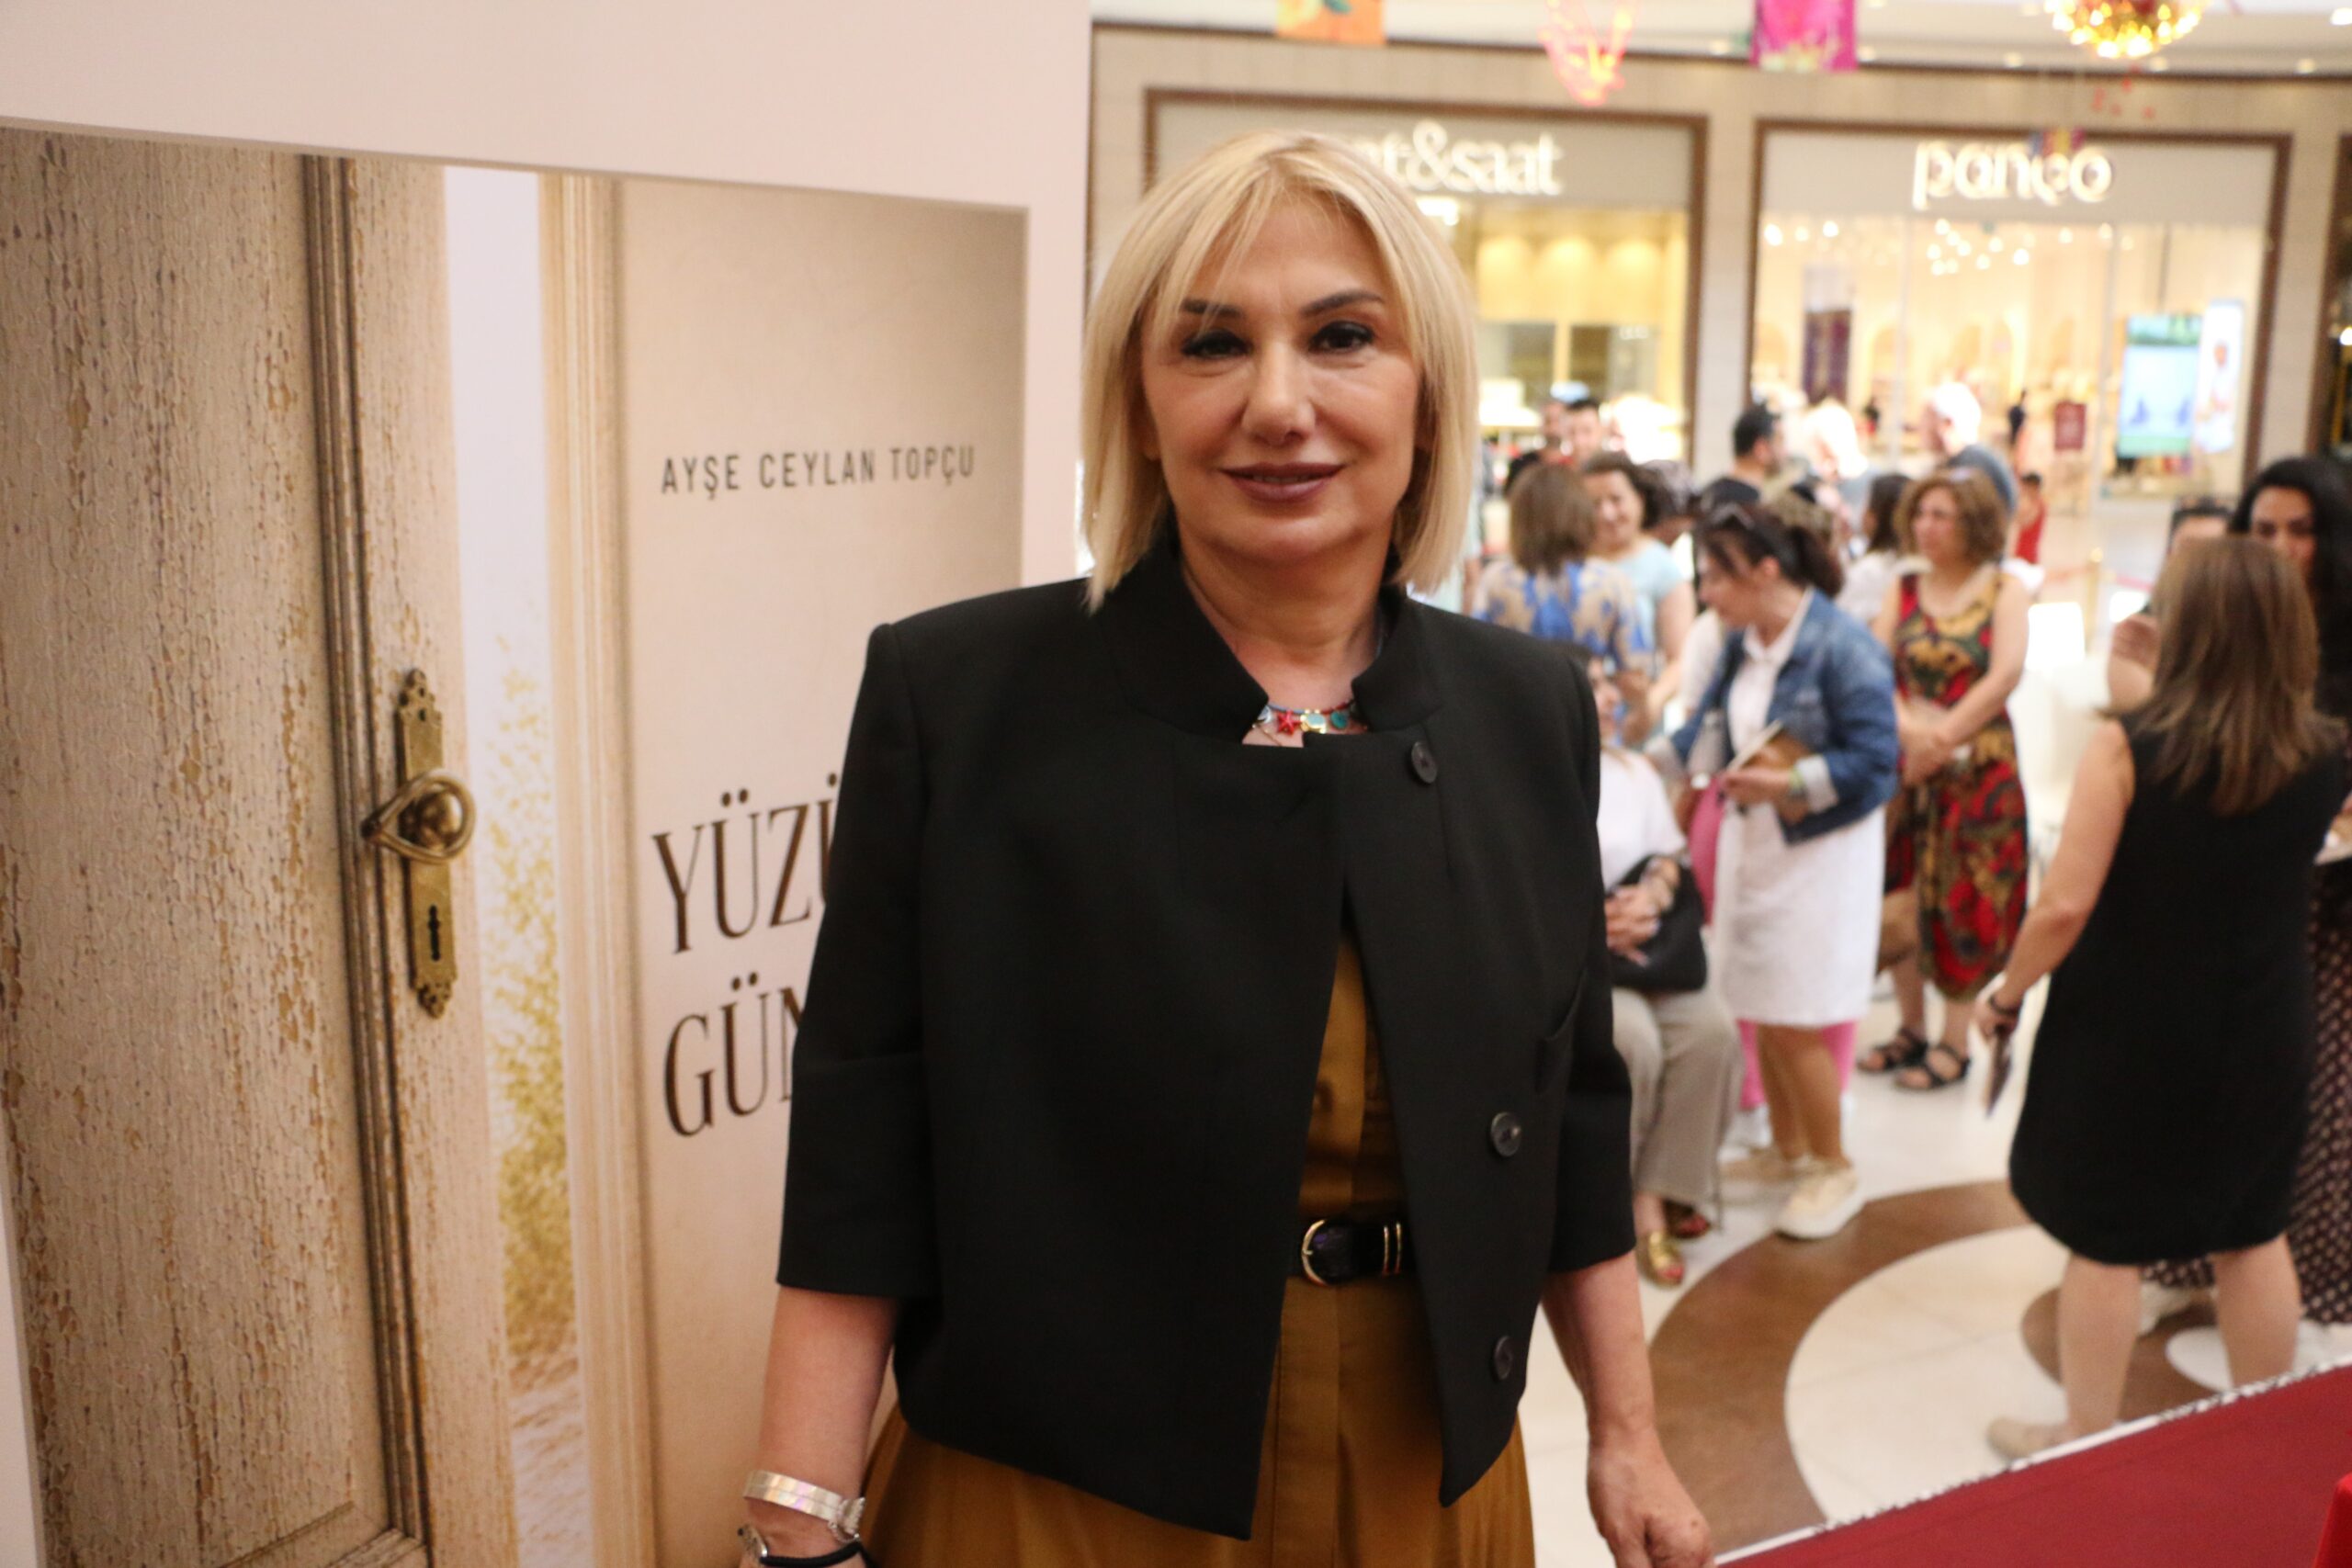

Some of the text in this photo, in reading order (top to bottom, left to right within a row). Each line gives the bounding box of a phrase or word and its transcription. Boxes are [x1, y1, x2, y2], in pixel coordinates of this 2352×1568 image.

[661, 445, 975, 500] AYŞE CEYLAN TOPÇU
